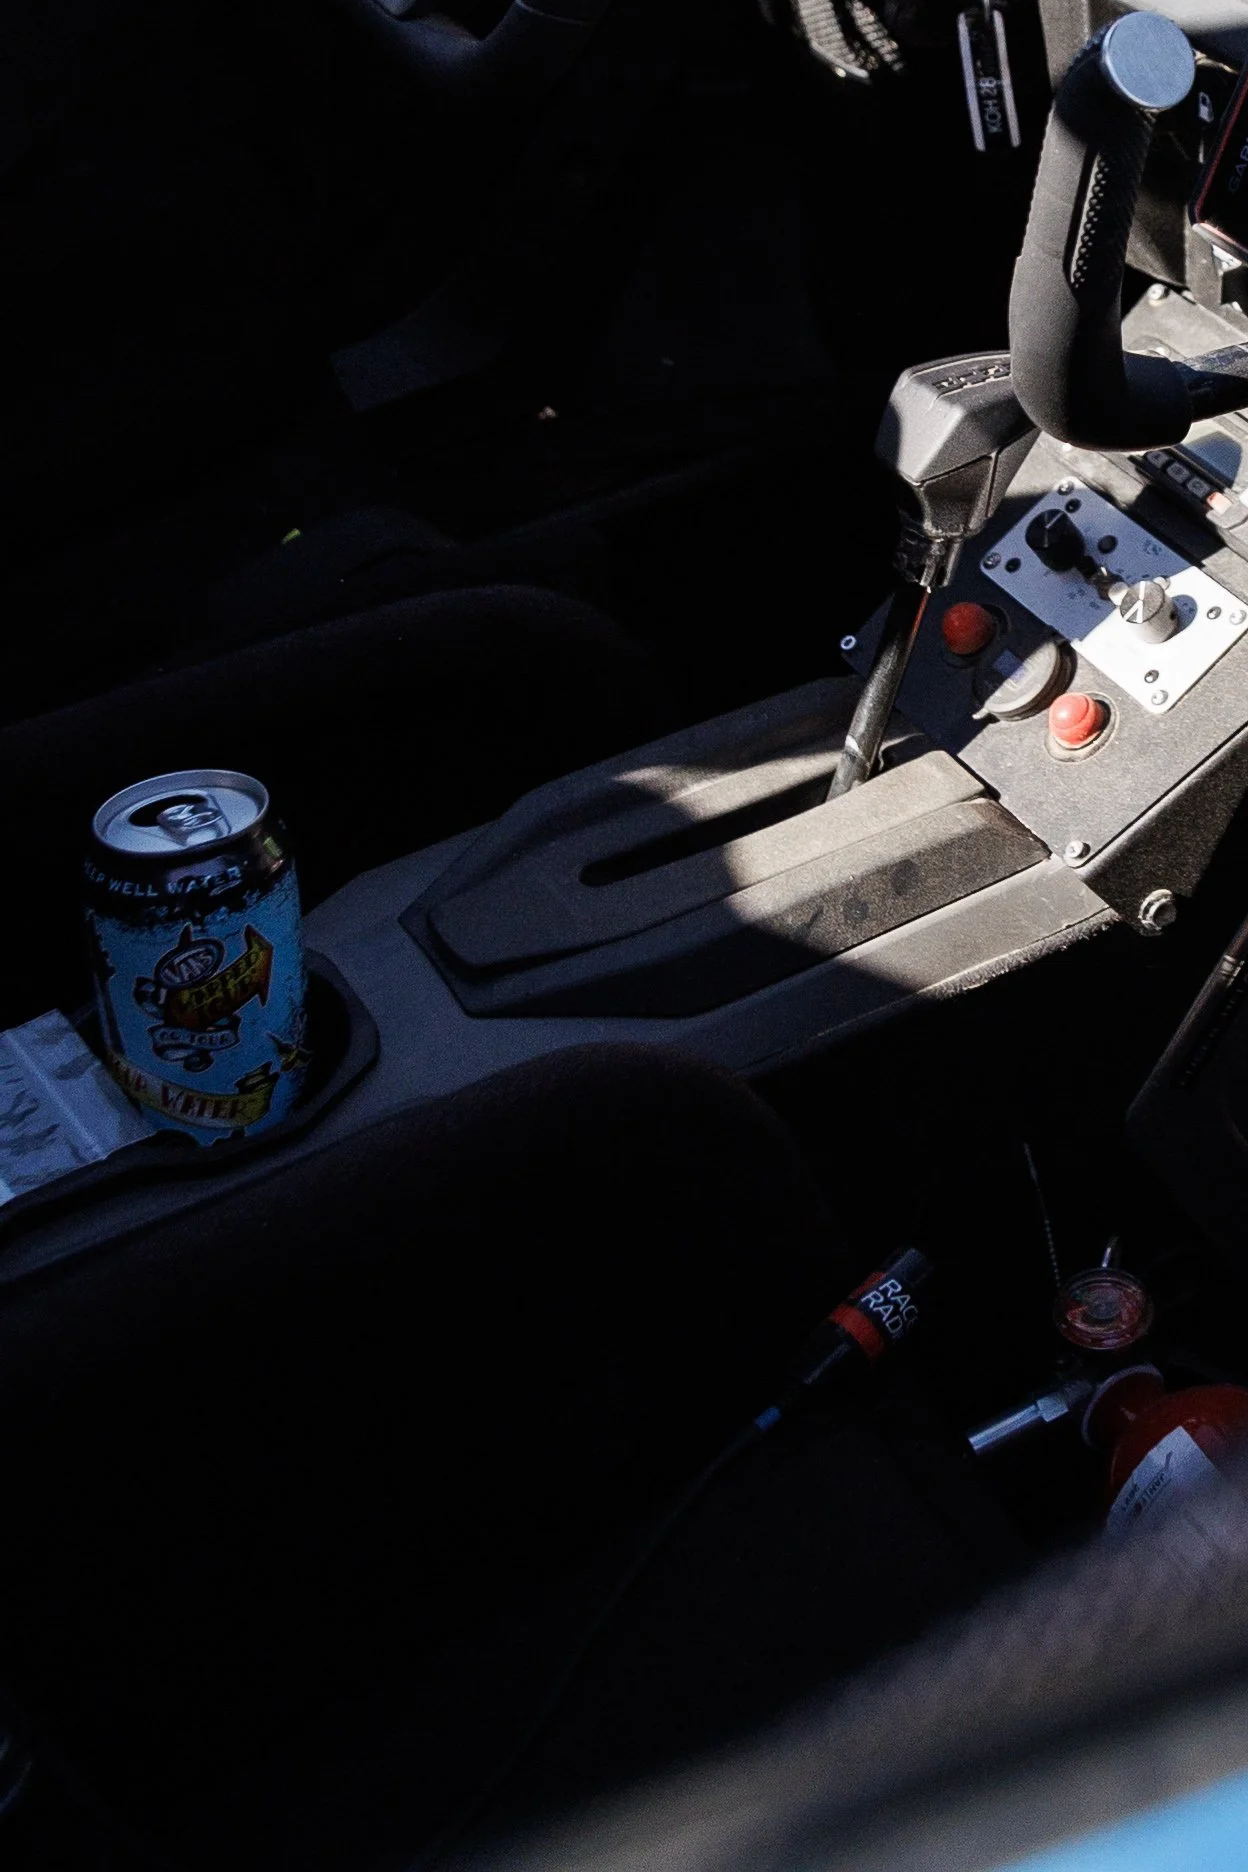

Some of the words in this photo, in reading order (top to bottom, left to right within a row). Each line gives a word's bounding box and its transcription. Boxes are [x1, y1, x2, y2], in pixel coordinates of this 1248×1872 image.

[108, 878, 160, 897] WELL
[166, 865, 243, 895] WATER
[158, 947, 214, 984] VANS
[860, 1290, 905, 1338] RAD
